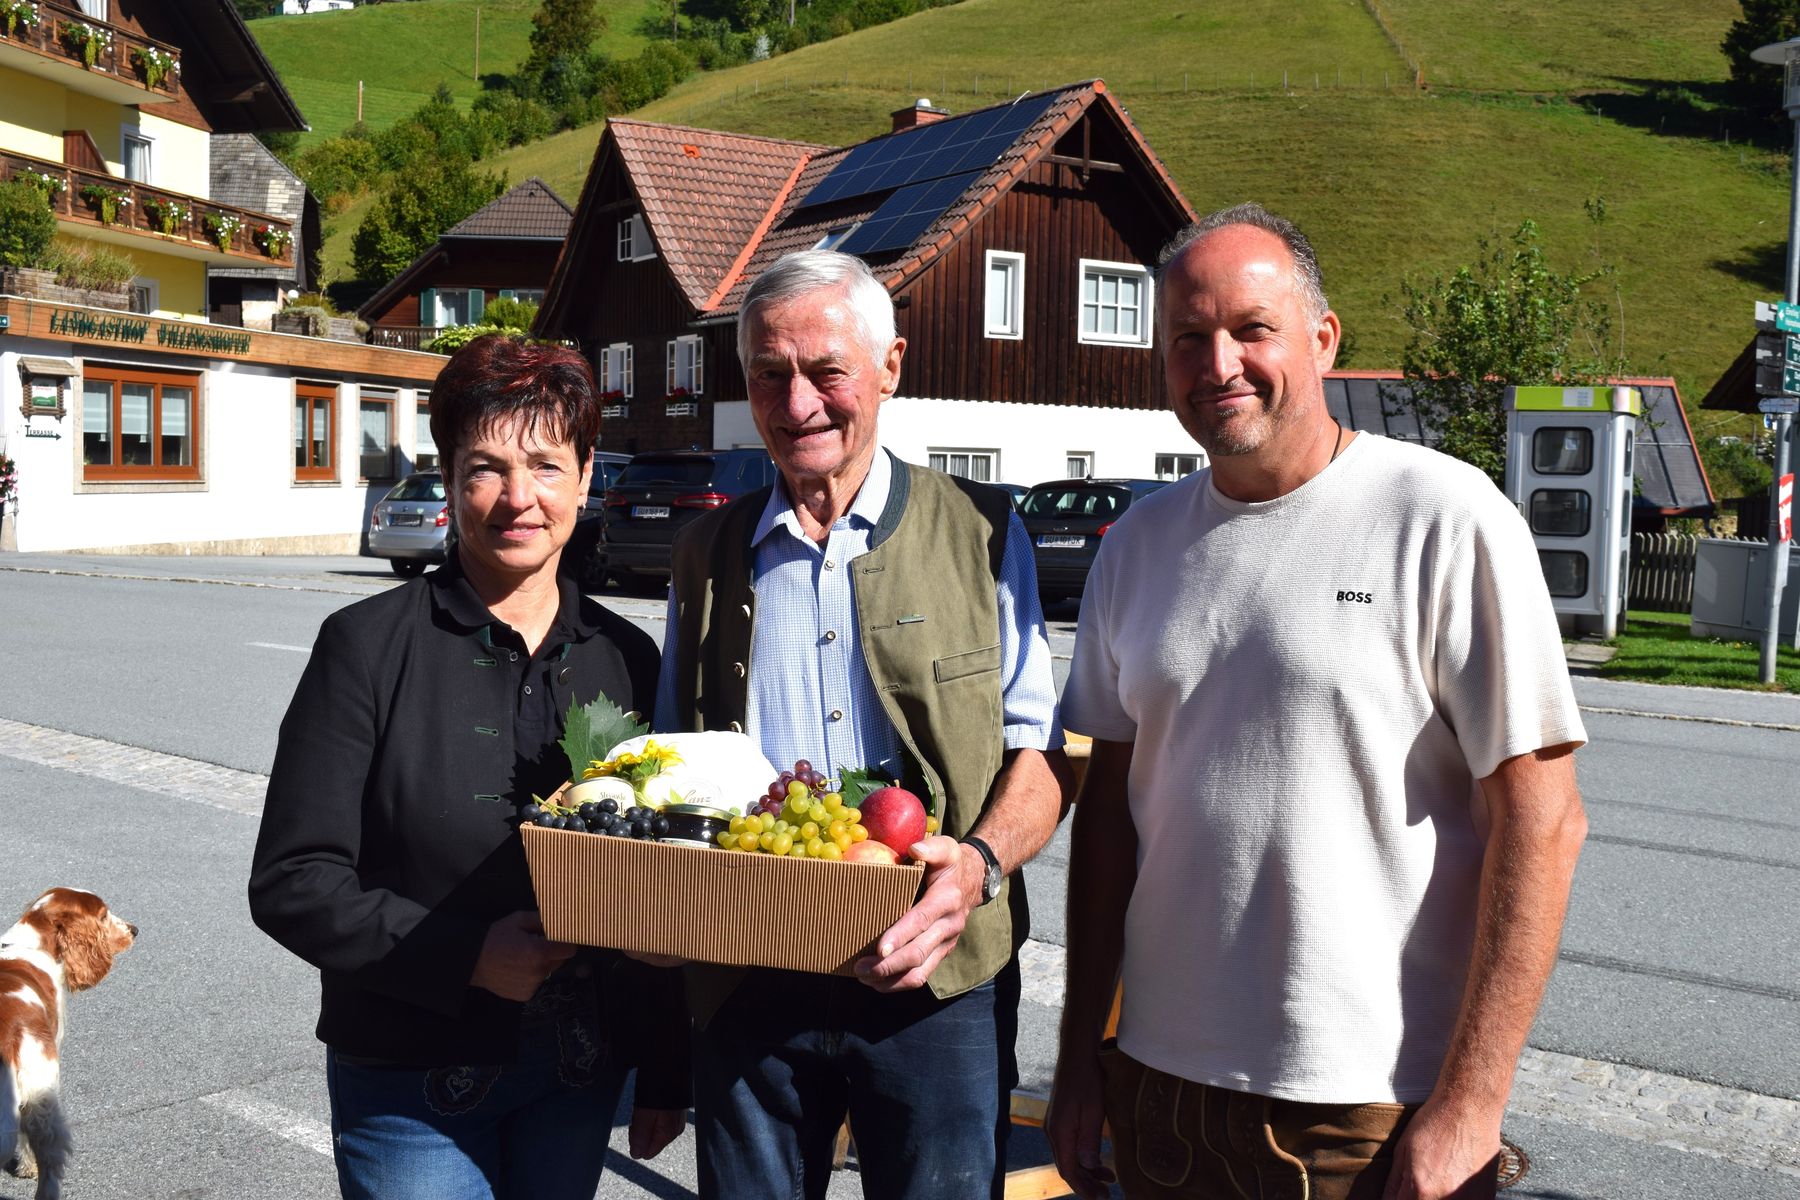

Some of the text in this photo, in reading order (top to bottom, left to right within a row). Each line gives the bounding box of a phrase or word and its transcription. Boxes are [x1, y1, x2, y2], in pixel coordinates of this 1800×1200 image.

[50, 309, 150, 343] LANDGASTHOF
[25, 425, 54, 436] TERRASSE
[1336, 591, 1373, 604] BOSS
